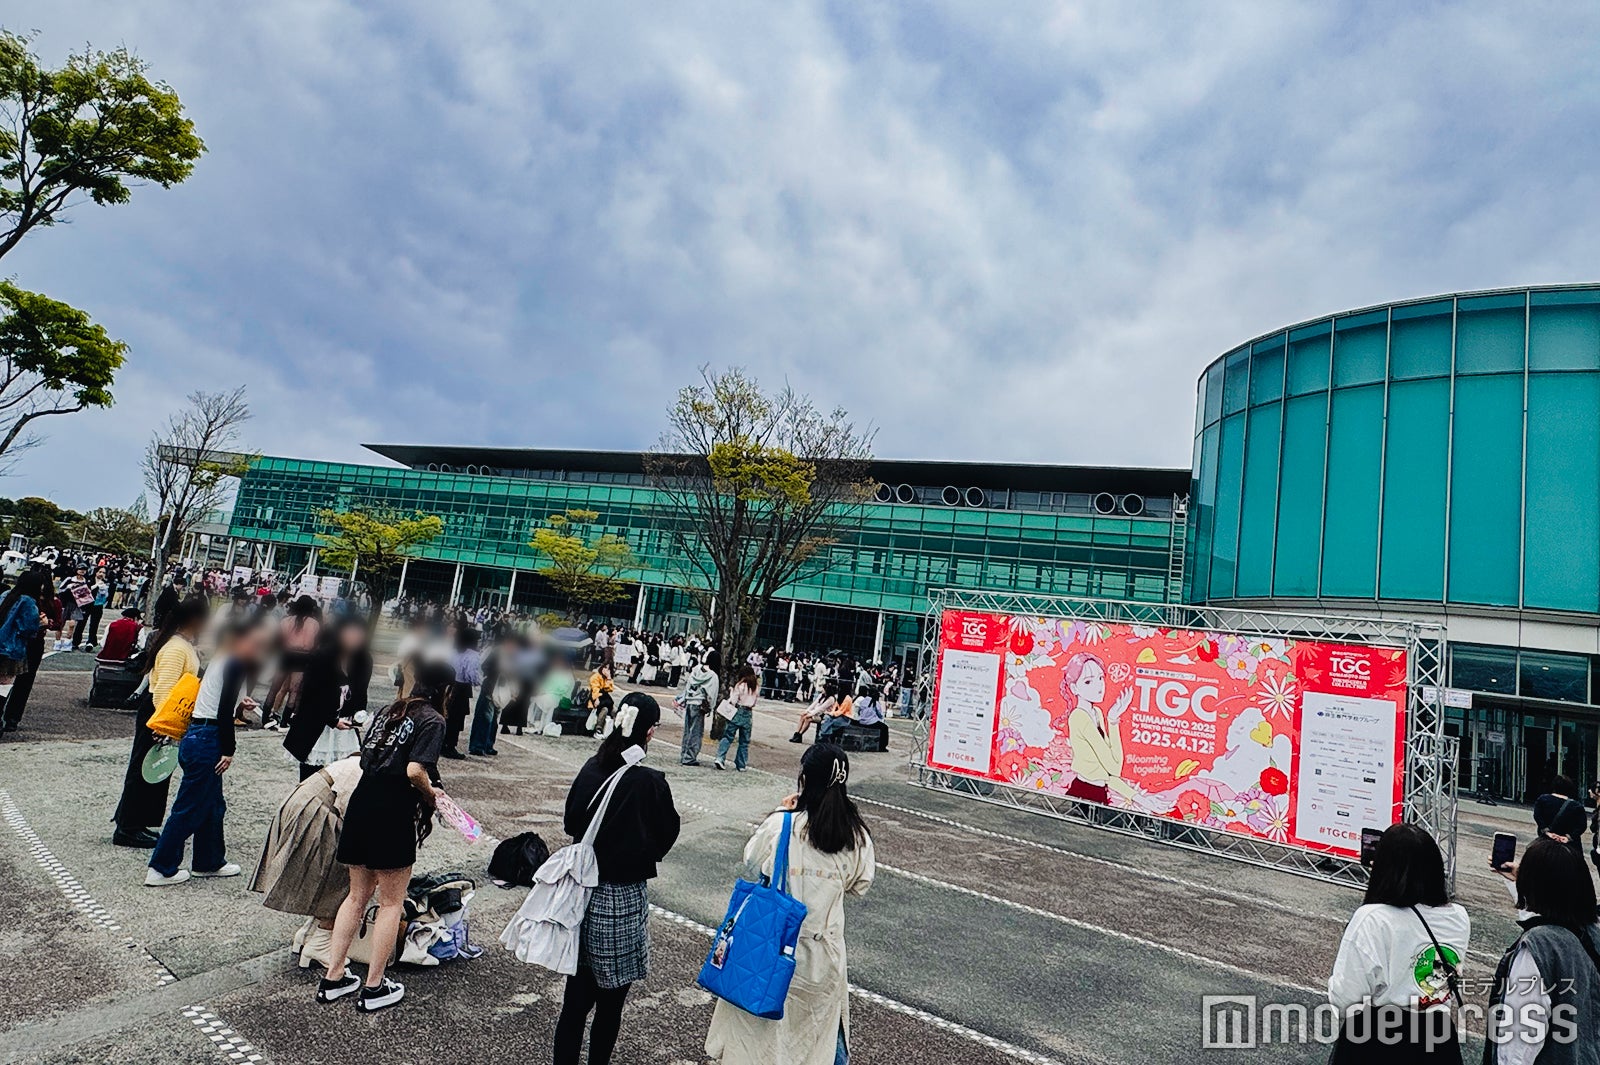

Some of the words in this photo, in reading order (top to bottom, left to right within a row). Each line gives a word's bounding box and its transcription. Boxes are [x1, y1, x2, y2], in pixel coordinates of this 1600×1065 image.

[961, 621, 987, 636] TGC
[1329, 657, 1371, 676] TGC
[1135, 678, 1219, 722] TGC
[1132, 713, 1189, 729] KUMAMOTO
[1191, 721, 1216, 733] 2025
[1140, 723, 1161, 732] TOKYO
[1162, 725, 1179, 734] GIRLS
[1179, 728, 1216, 740] COLLECTION
[1131, 729, 1209, 754] 2025.4.12
[1126, 754, 1168, 766] Blooming
[1133, 763, 1172, 776] together
